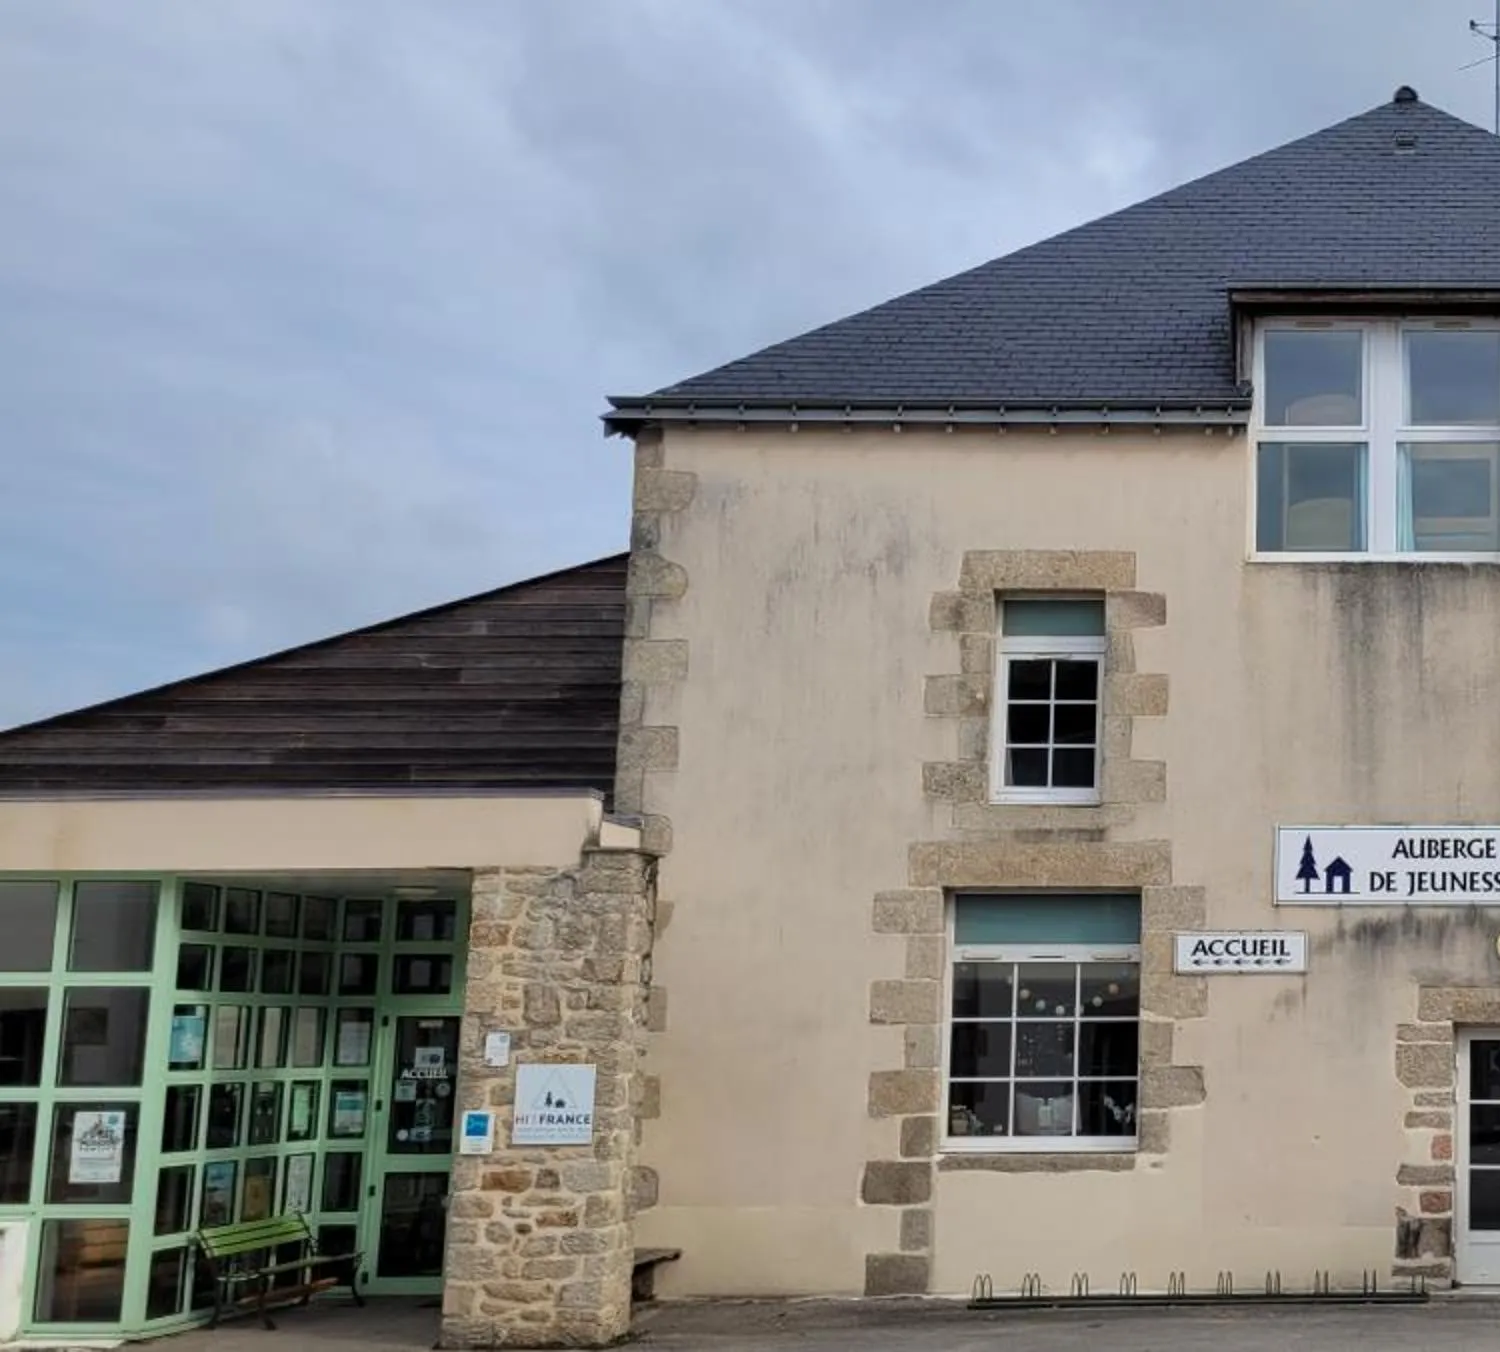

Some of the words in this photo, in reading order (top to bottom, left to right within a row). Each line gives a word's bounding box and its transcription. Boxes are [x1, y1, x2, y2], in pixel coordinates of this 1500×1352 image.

[1392, 839, 1498, 859] AUBERGE
[1369, 872, 1398, 893] DE
[1191, 939, 1291, 958] ACCUEIL
[401, 1068, 449, 1079] ACCUEIL
[539, 1114, 591, 1125] FRANCE
